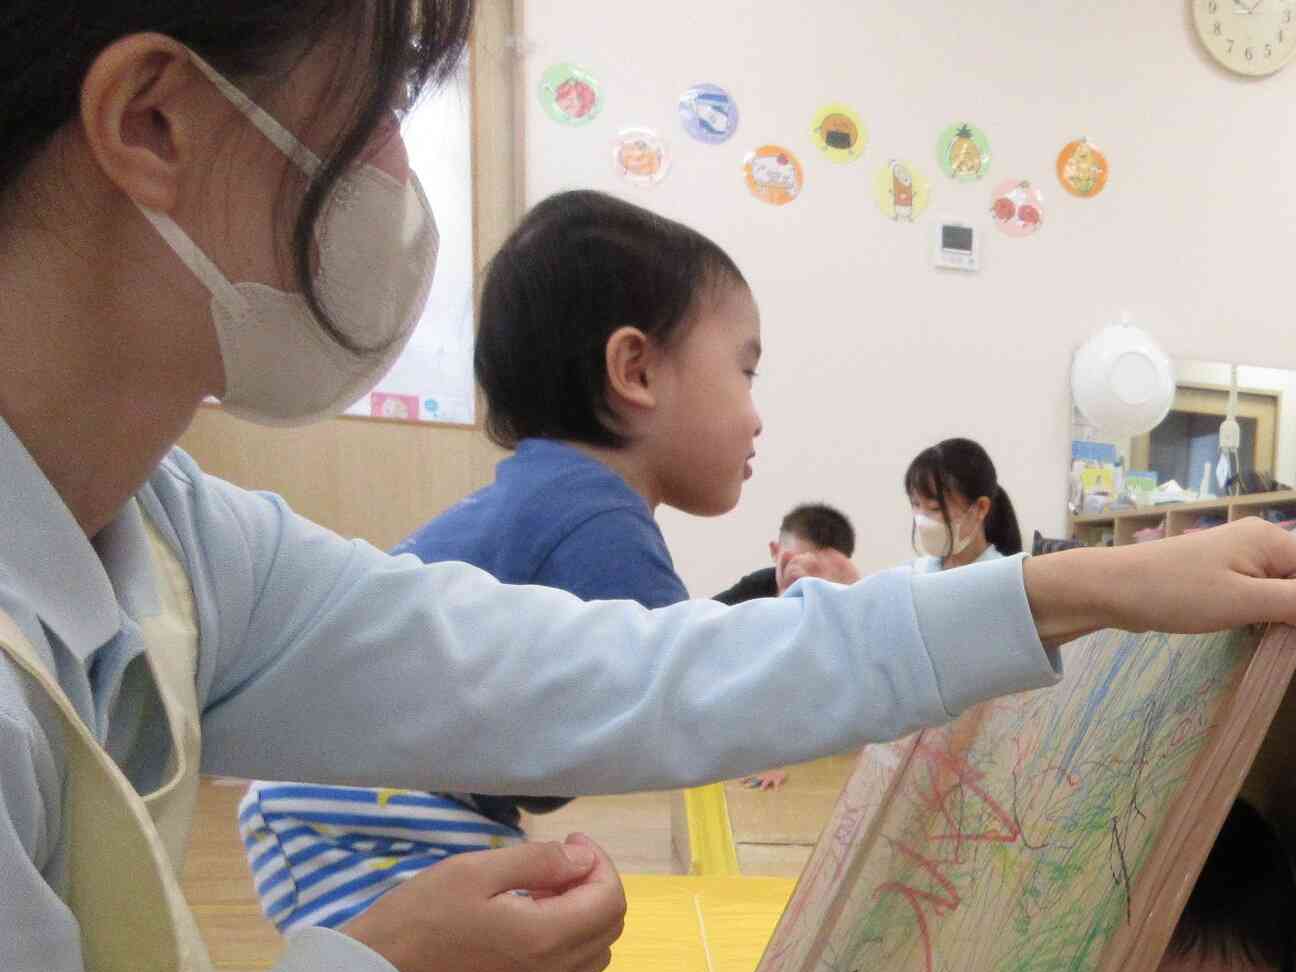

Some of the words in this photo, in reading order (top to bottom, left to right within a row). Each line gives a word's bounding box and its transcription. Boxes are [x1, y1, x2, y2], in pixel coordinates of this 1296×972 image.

[1226, 39, 1234, 54] 7
[1265, 43, 1272, 57] 5
[1244, 47, 1253, 61] 6
